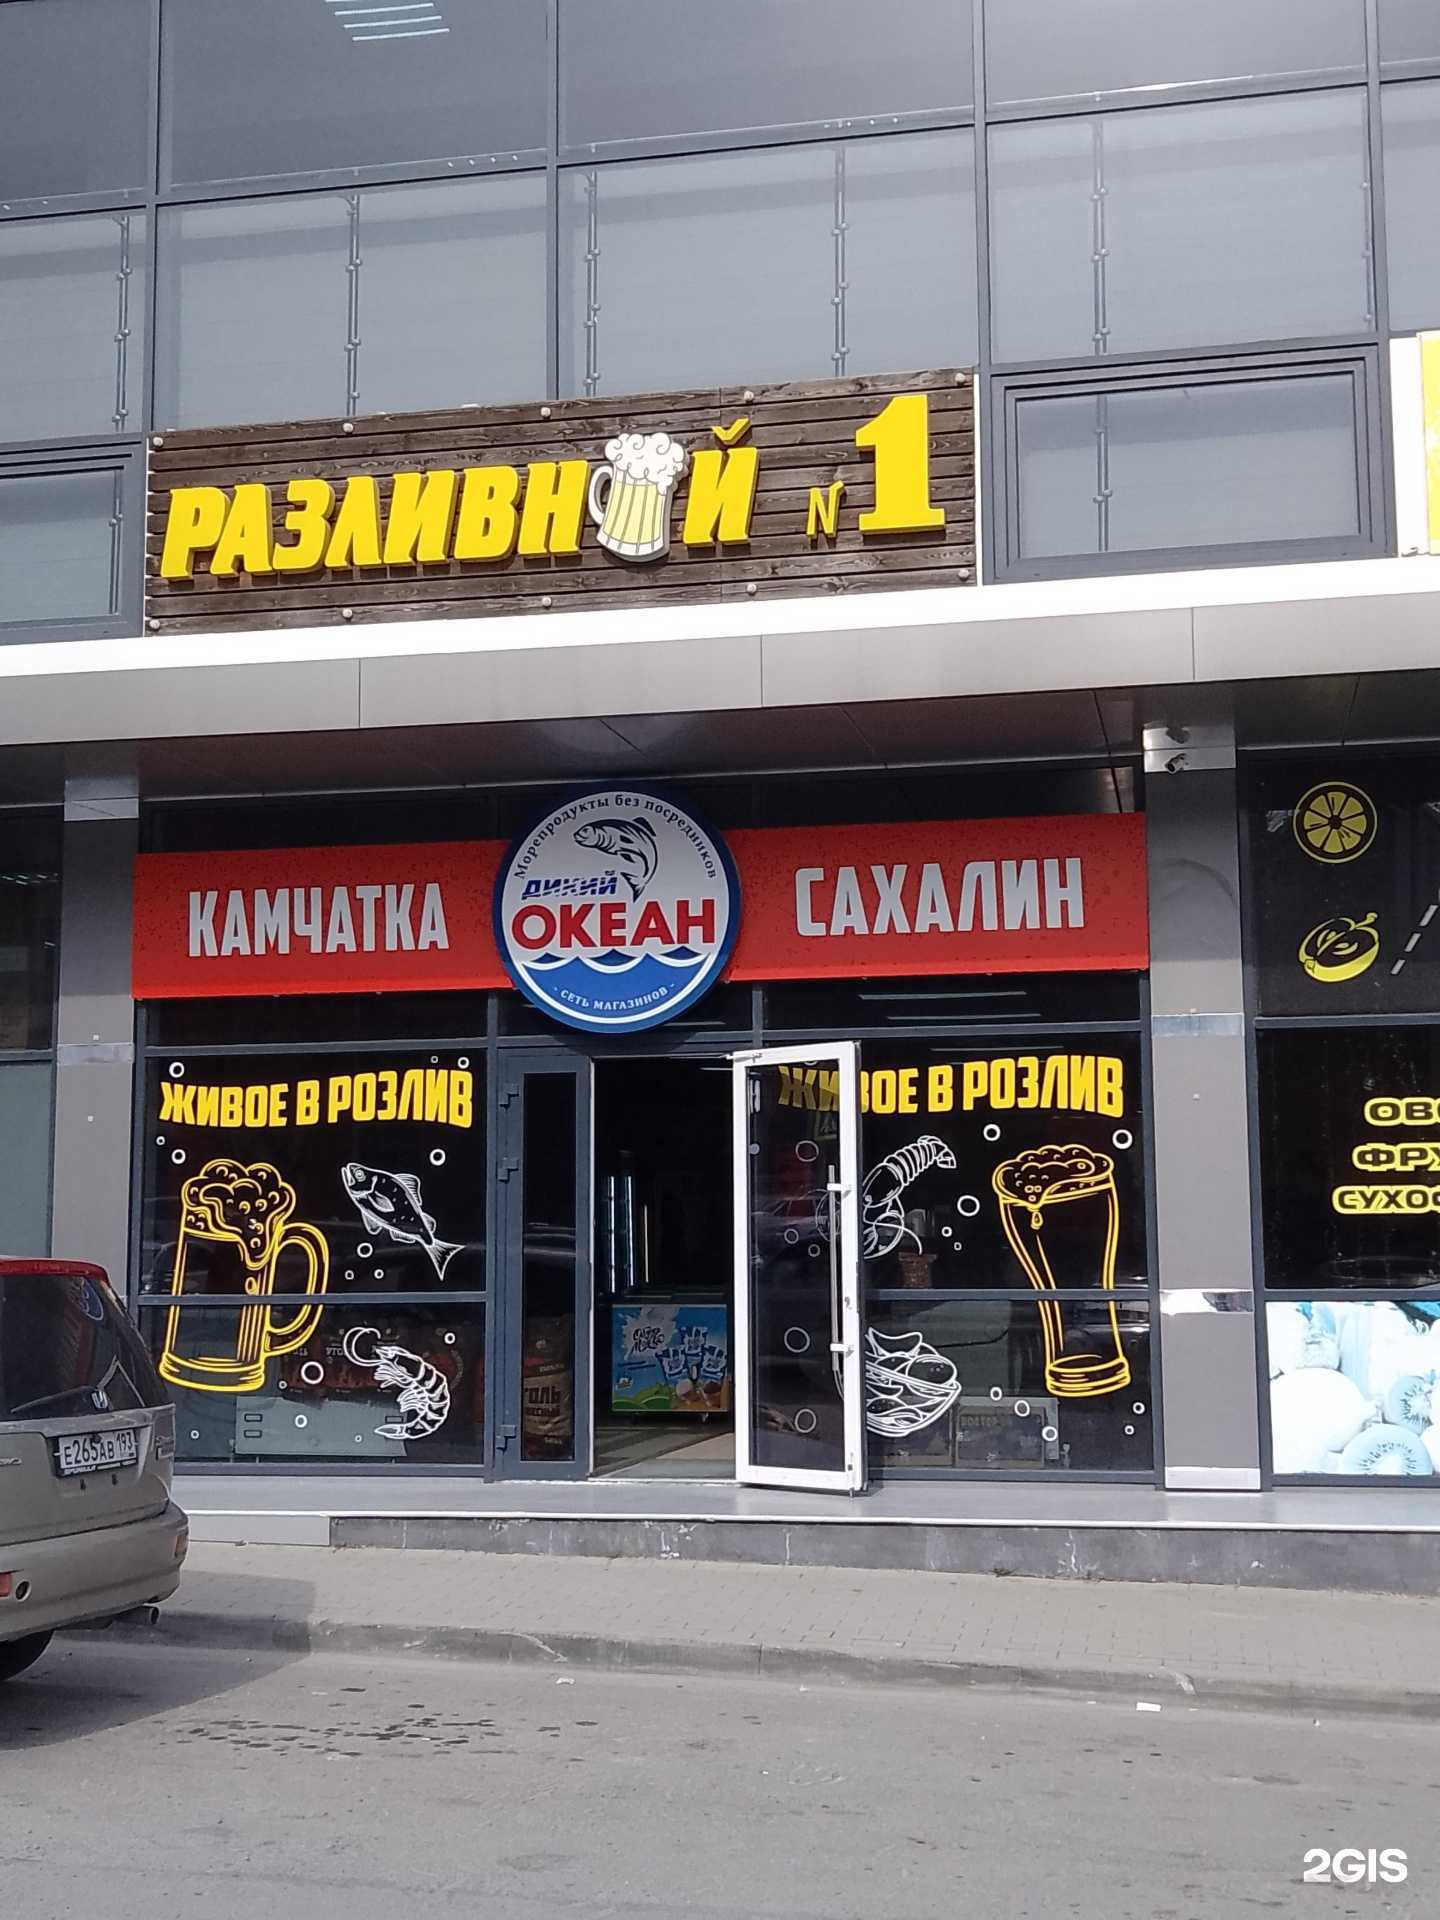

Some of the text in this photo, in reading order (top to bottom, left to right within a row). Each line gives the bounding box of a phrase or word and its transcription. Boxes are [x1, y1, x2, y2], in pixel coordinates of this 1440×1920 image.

[513, 794, 718, 880] Морепродукты без посредников
[188, 882, 450, 957] КАМЧАТКА
[511, 898, 716, 951] ОКЕАН
[794, 857, 1085, 937] САХАЛИН
[560, 986, 669, 1011] СЕТЬ МАГАЗИНОВ
[159, 1068, 474, 1128] ЖИВОЕ В РОЗЛИВ
[927, 1064, 954, 1113] В
[962, 1054, 1124, 1118] РОЗЛИВ
[1364, 1097, 1440, 1126] ОВ
